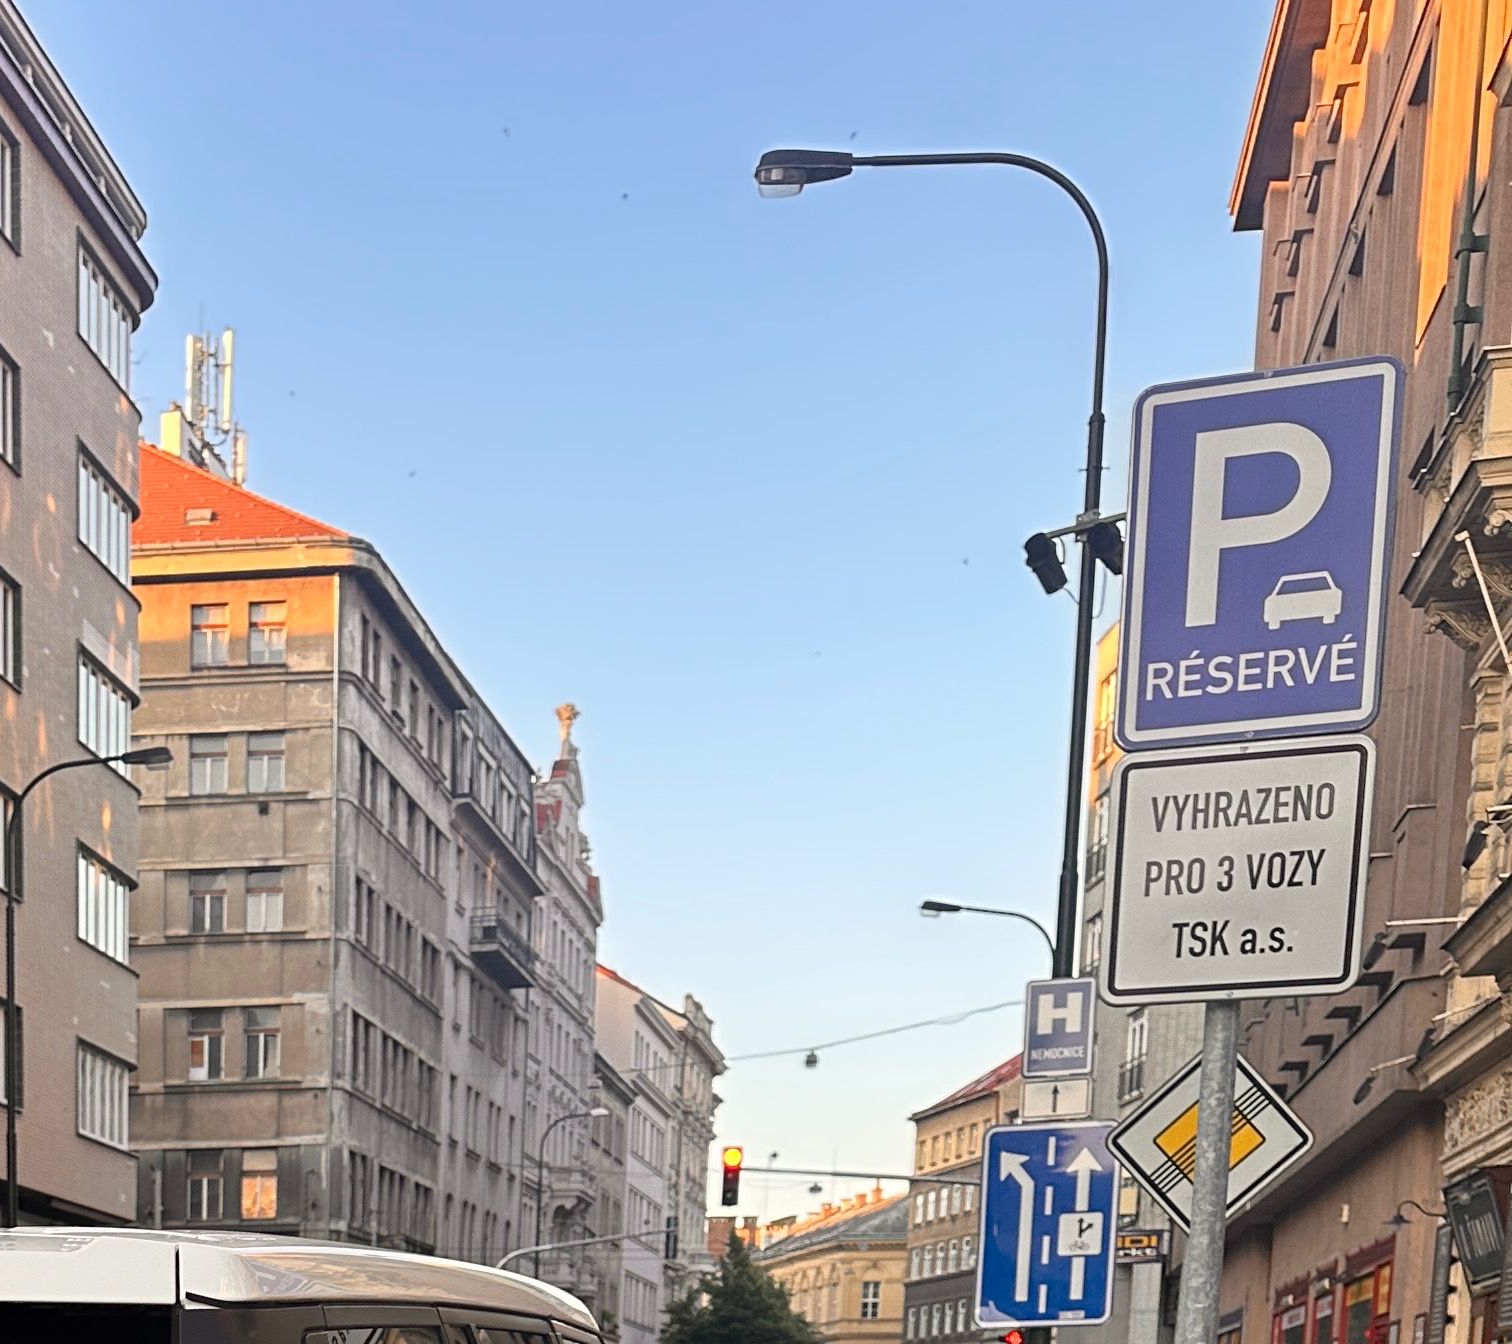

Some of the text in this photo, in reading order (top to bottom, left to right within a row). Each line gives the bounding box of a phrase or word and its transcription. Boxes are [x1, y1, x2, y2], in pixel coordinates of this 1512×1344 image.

[1185, 422, 1332, 627] P
[1146, 634, 1357, 701] RÉSERVÉ
[1151, 782, 1335, 832] VYHRAZENO
[1144, 848, 1326, 897] PRO 3 VOZY
[1172, 920, 1294, 958] TSK a.s.
[1037, 992, 1083, 1035] H
